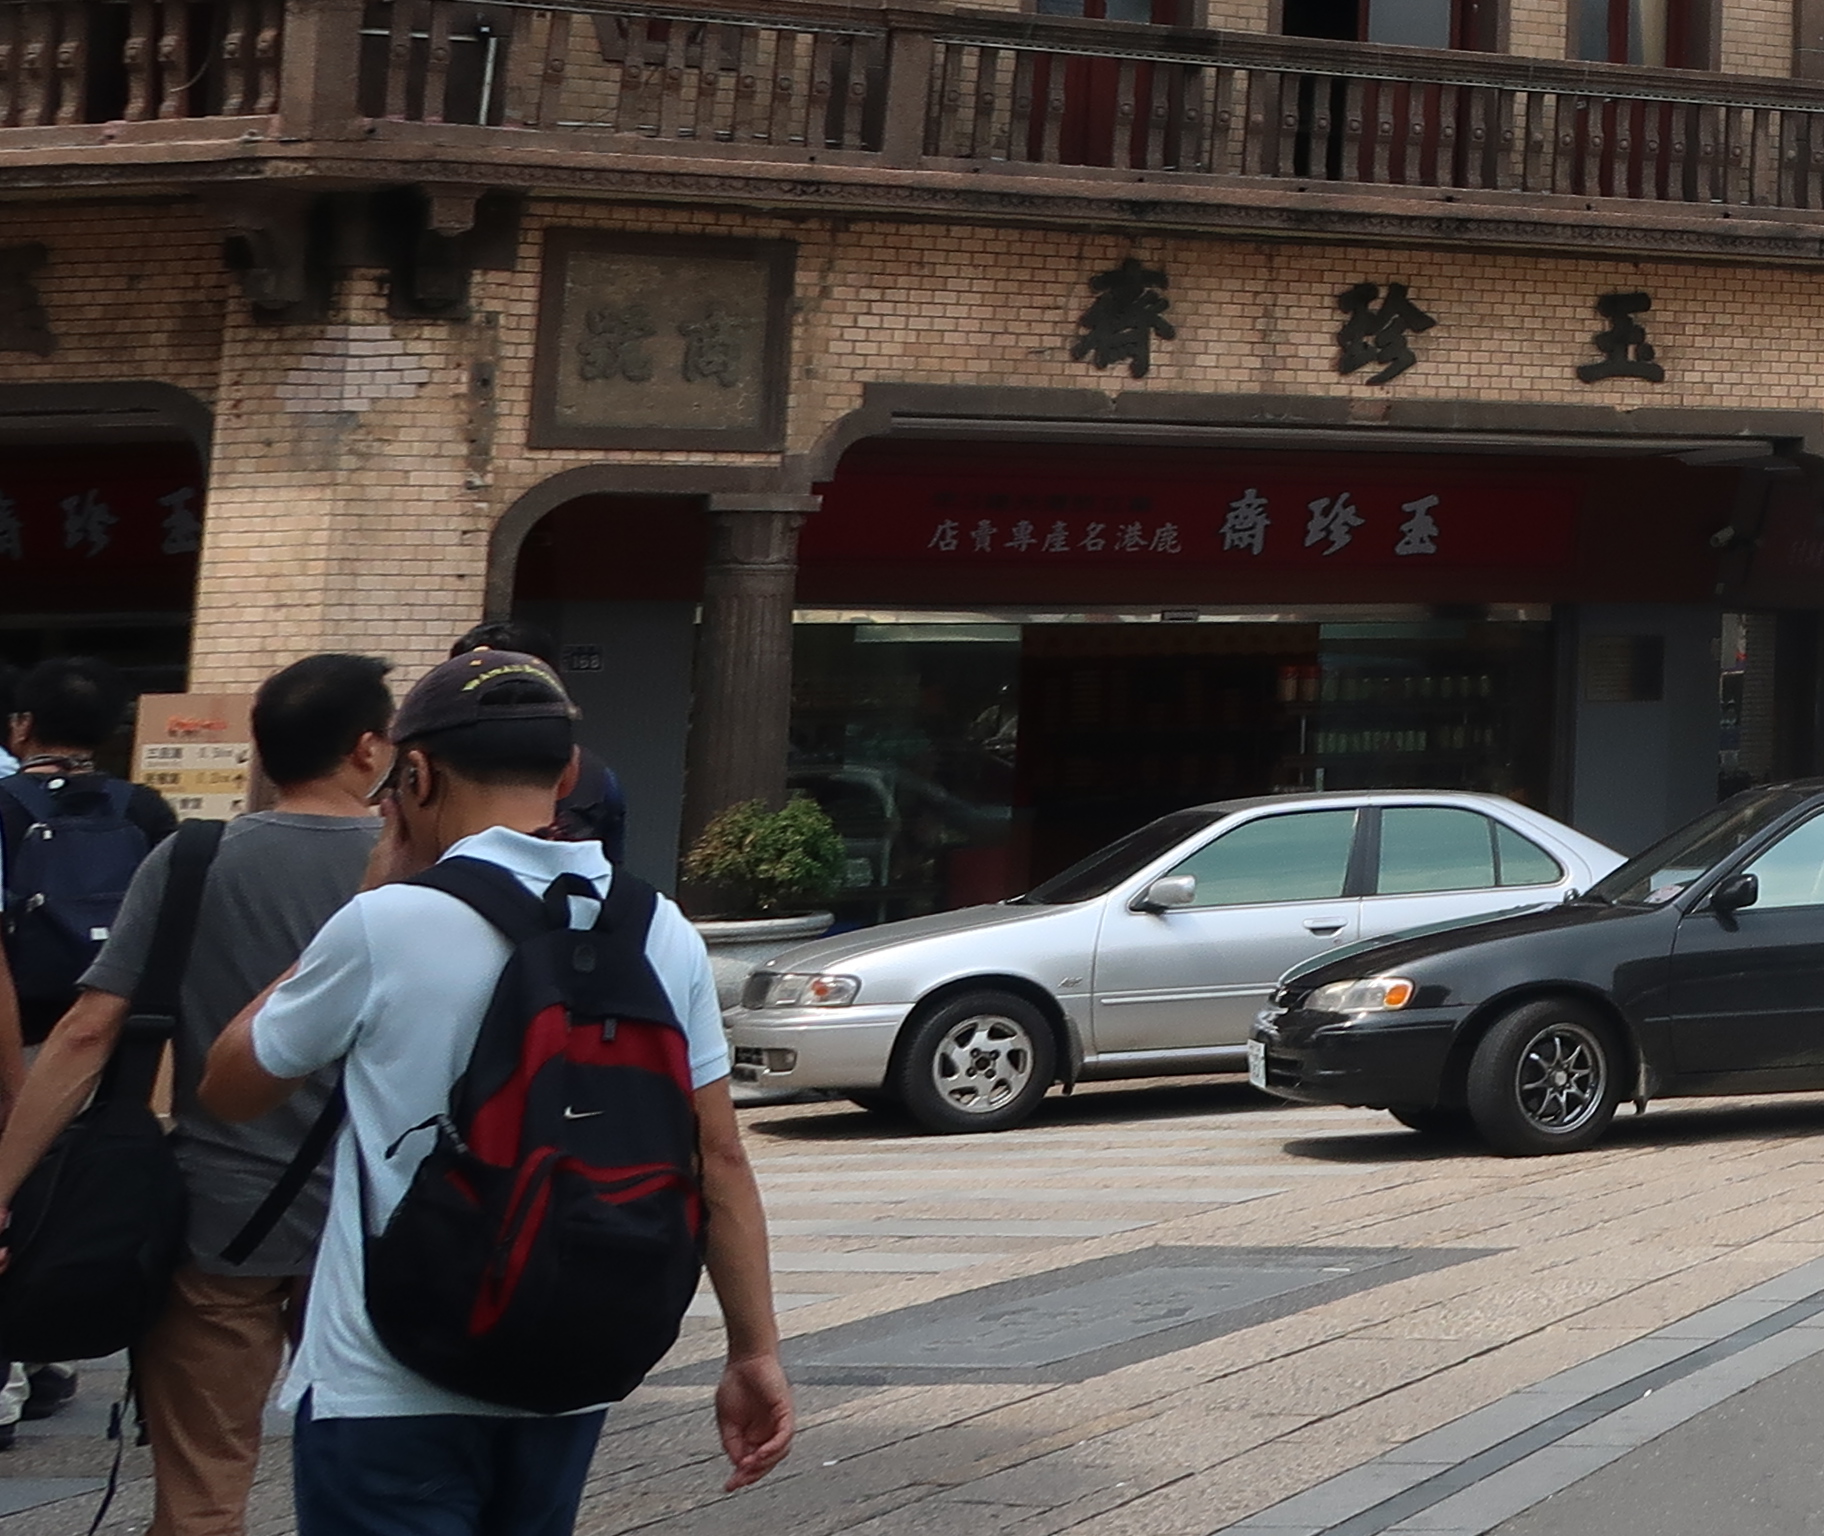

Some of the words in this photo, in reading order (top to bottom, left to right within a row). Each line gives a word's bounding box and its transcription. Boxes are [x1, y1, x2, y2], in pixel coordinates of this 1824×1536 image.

[1072, 258, 1665, 385] 玉珍齋
[926, 519, 1184, 556] 鹿港名產專賣店
[1219, 486, 1441, 558] 玉珍齋
